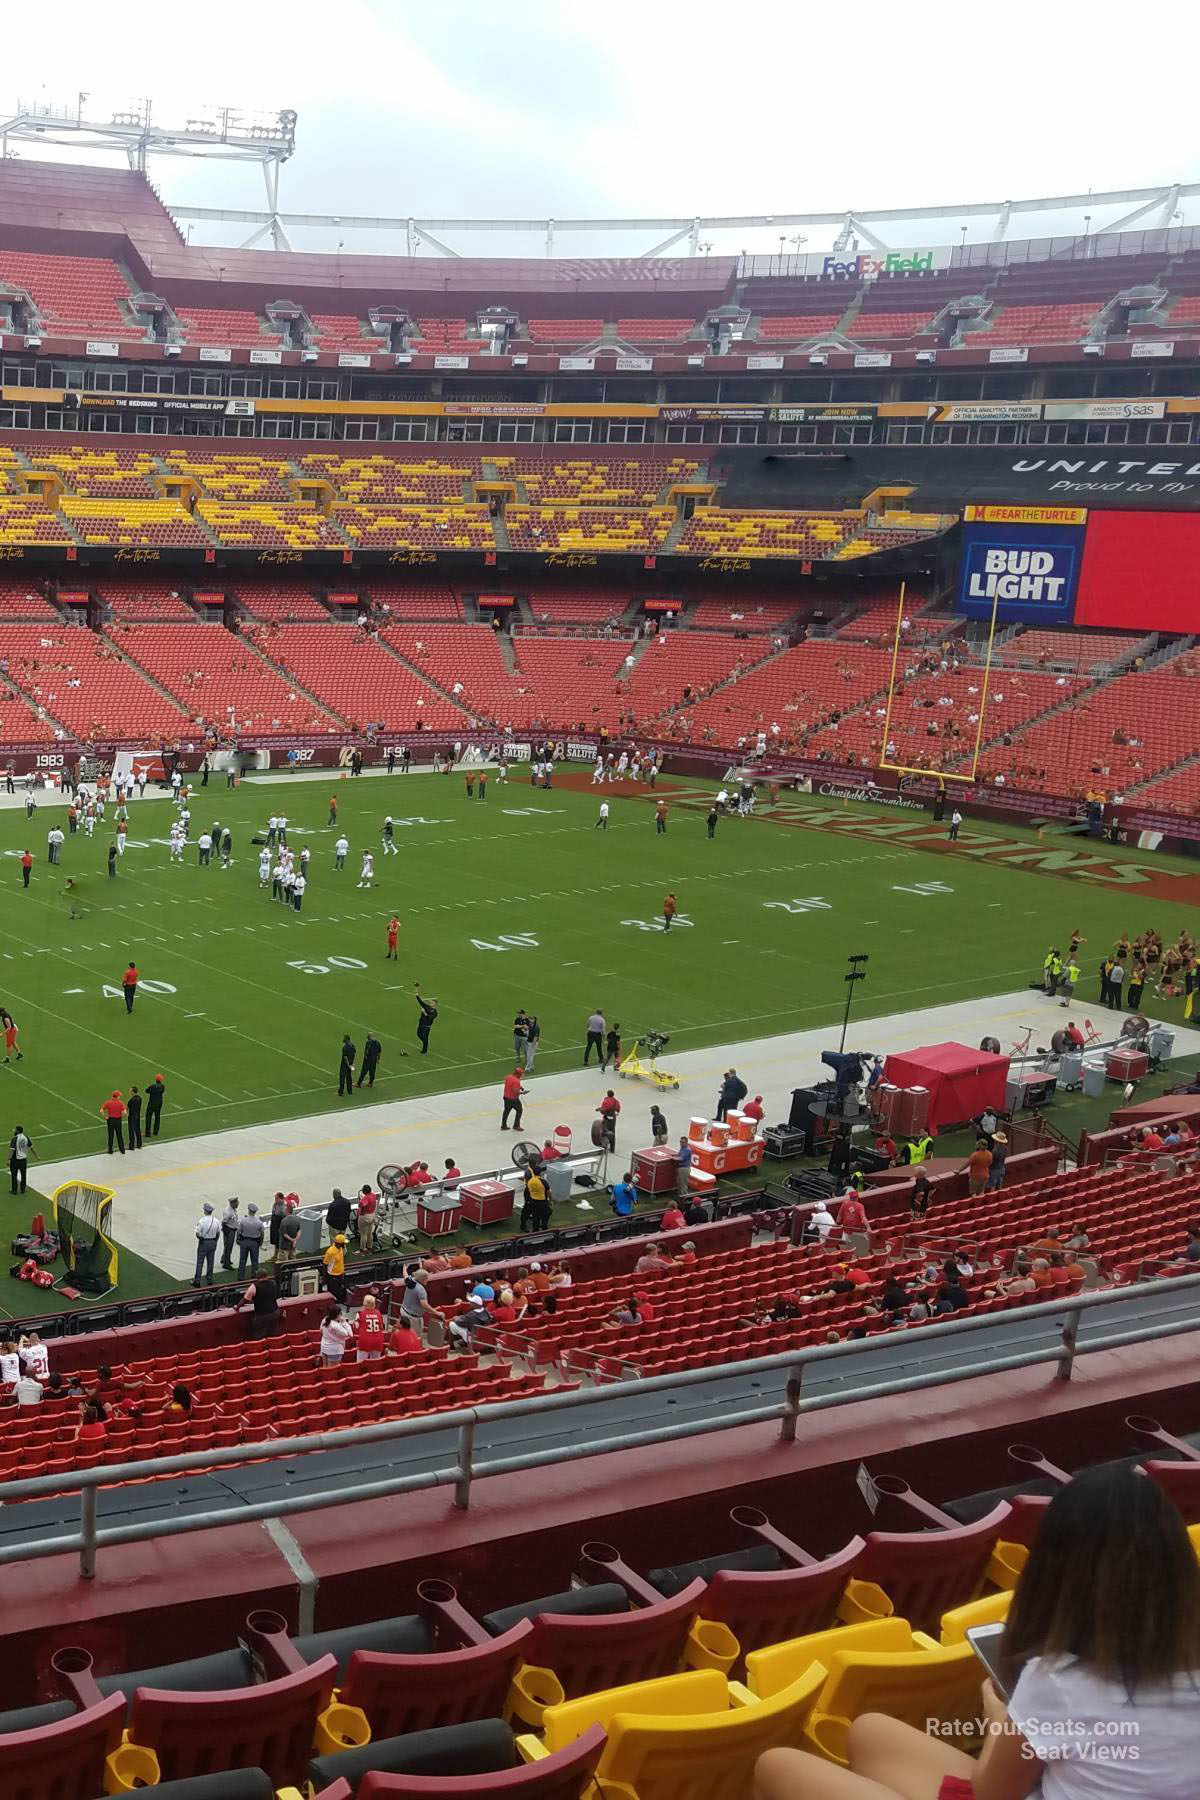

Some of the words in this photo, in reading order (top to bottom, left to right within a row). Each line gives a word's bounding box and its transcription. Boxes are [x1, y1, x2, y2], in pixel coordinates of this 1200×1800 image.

[822, 251, 933, 274] FedExField
[778, 413, 805, 421] SALUTE
[1132, 405, 1154, 416] sas
[1048, 480, 1126, 492] Proud
[1126, 482, 1154, 492] to
[1158, 481, 1195, 494] fly
[989, 509, 1077, 521] #FEARTHETURTLE
[985, 549, 1054, 575] BUD
[969, 573, 1063, 601] LIGHT
[36, 754, 64, 767] 1983
[566, 750, 597, 759] SALUTE
[819, 782, 869, 802] Charitable
[868, 789, 925, 809] Foundation
[762, 896, 833, 914] 20
[285, 955, 369, 976] 50
[691, 1154, 700, 1166] G
[714, 1152, 726, 1170] G
[747, 1145, 759, 1163] G
[365, 1319, 380, 1333] 36
[33, 1359, 48, 1373] 21
